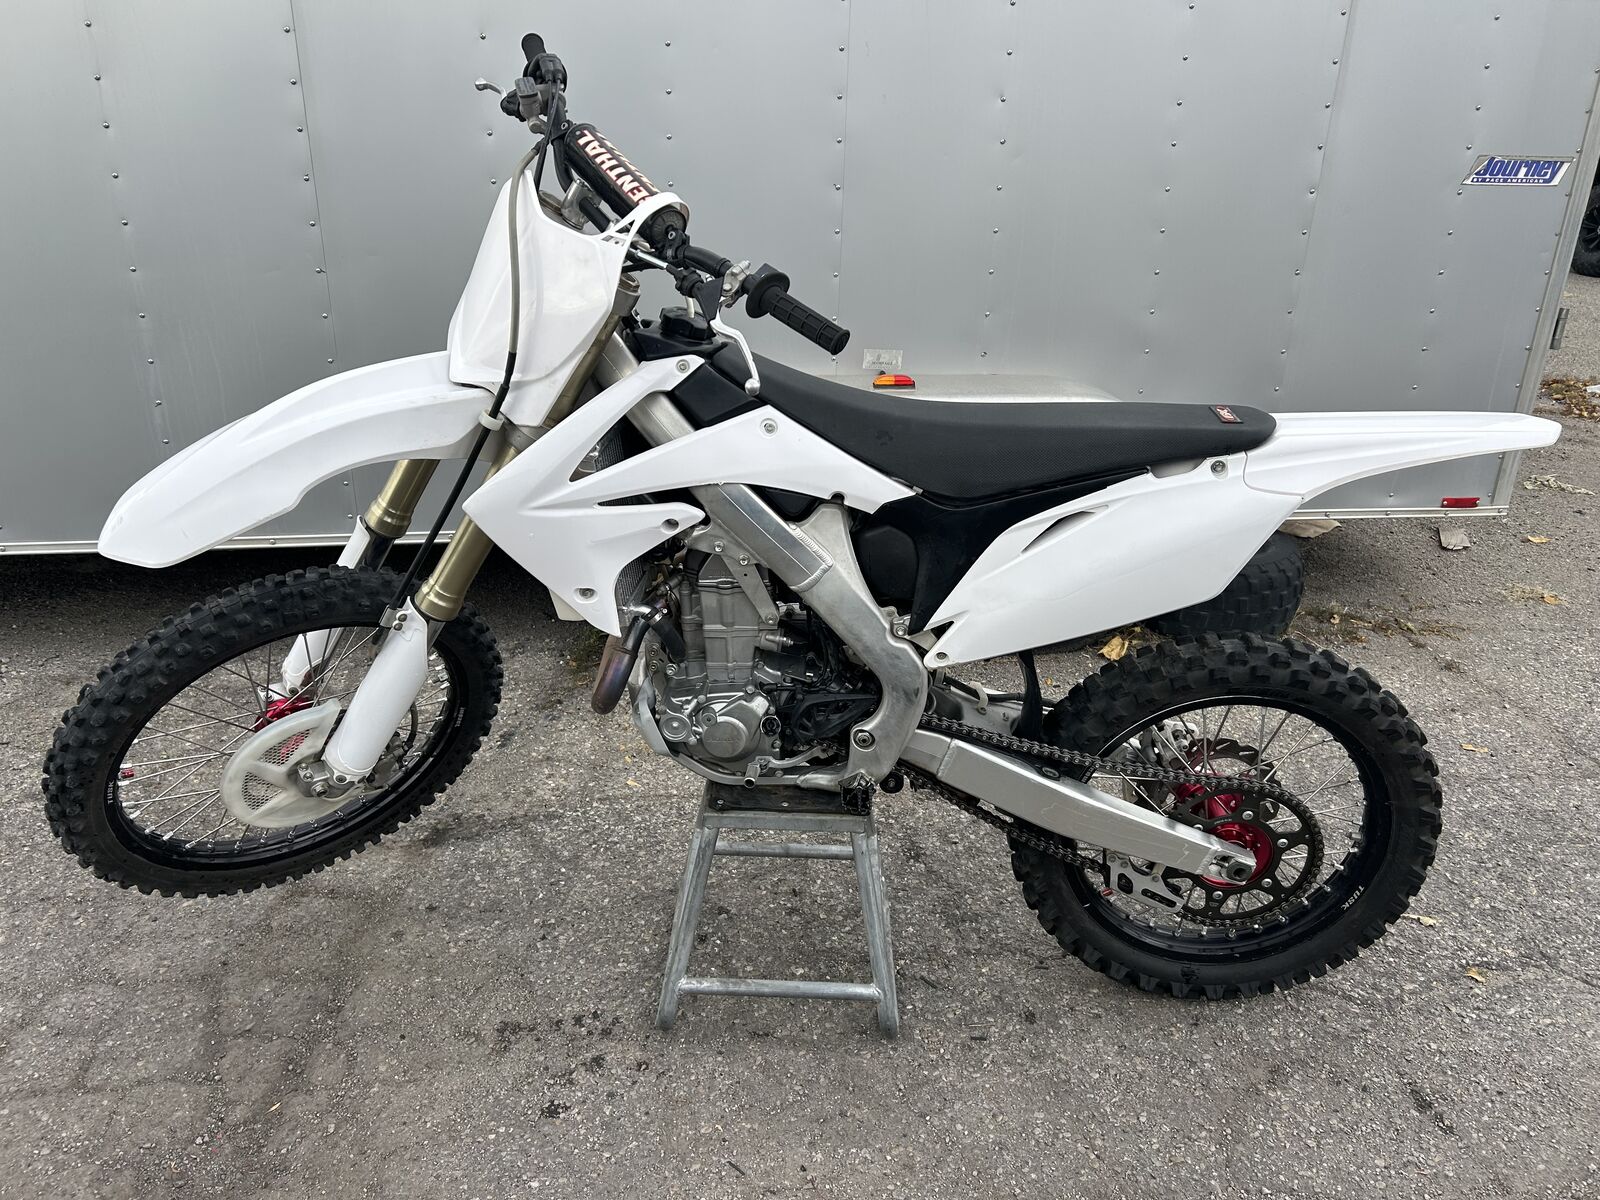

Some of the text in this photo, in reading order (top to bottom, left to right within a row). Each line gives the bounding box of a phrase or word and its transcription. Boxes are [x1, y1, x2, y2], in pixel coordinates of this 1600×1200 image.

[576, 129, 653, 206] ENTHAL
[1474, 156, 1565, 184] Journey
[106, 780, 115, 804] TUSK
[1341, 885, 1365, 910] TUSK
